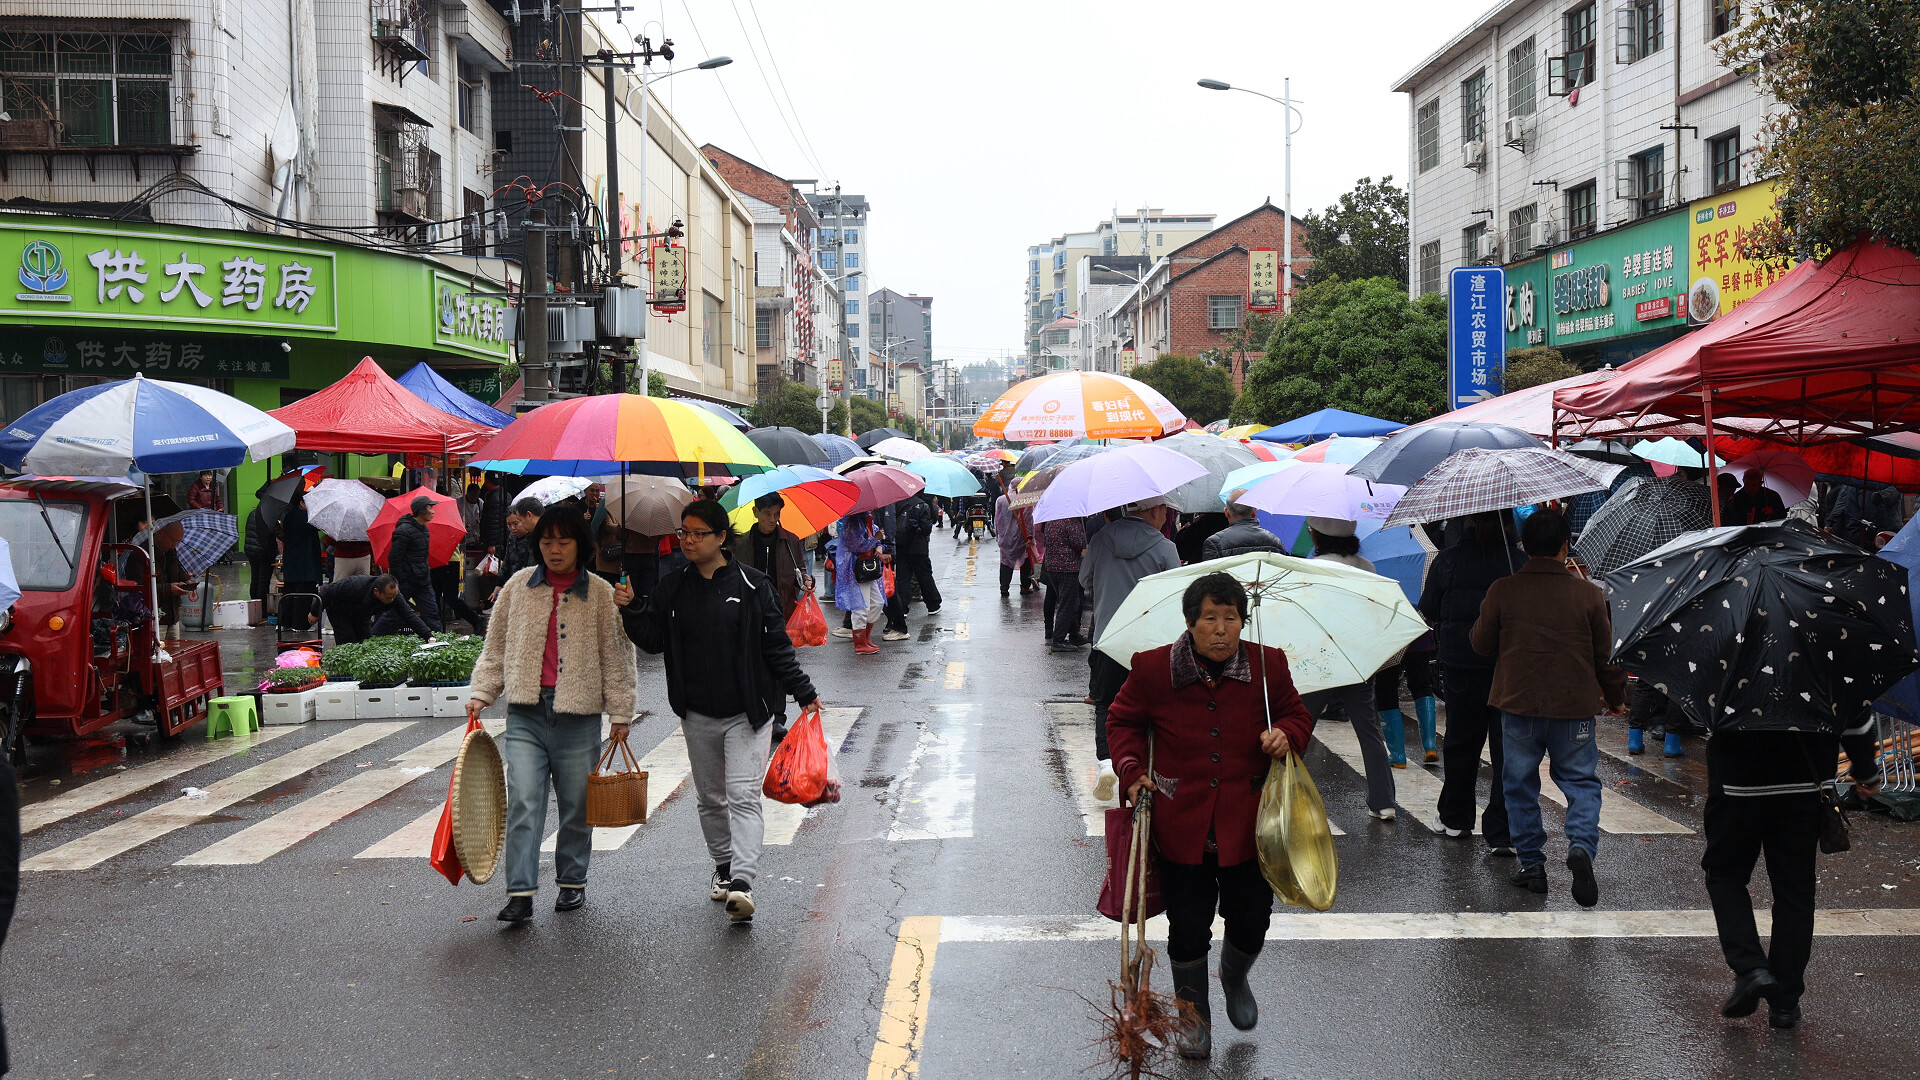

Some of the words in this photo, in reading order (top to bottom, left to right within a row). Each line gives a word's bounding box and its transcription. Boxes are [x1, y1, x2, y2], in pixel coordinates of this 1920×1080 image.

[1623, 245, 1673, 279] 孕婴童连锁
[88, 248, 317, 314] 供大药房
[1470, 274, 1487, 386] 渣江农贸市场
[76, 339, 205, 370] 供大药房
[217, 358, 272, 374] 关注健康
[1091, 399, 1130, 411] 看妇科
[1105, 409, 1145, 422] 到现代
[1034, 429, 1046, 437] 227
[1049, 429, 1073, 437] 88888
